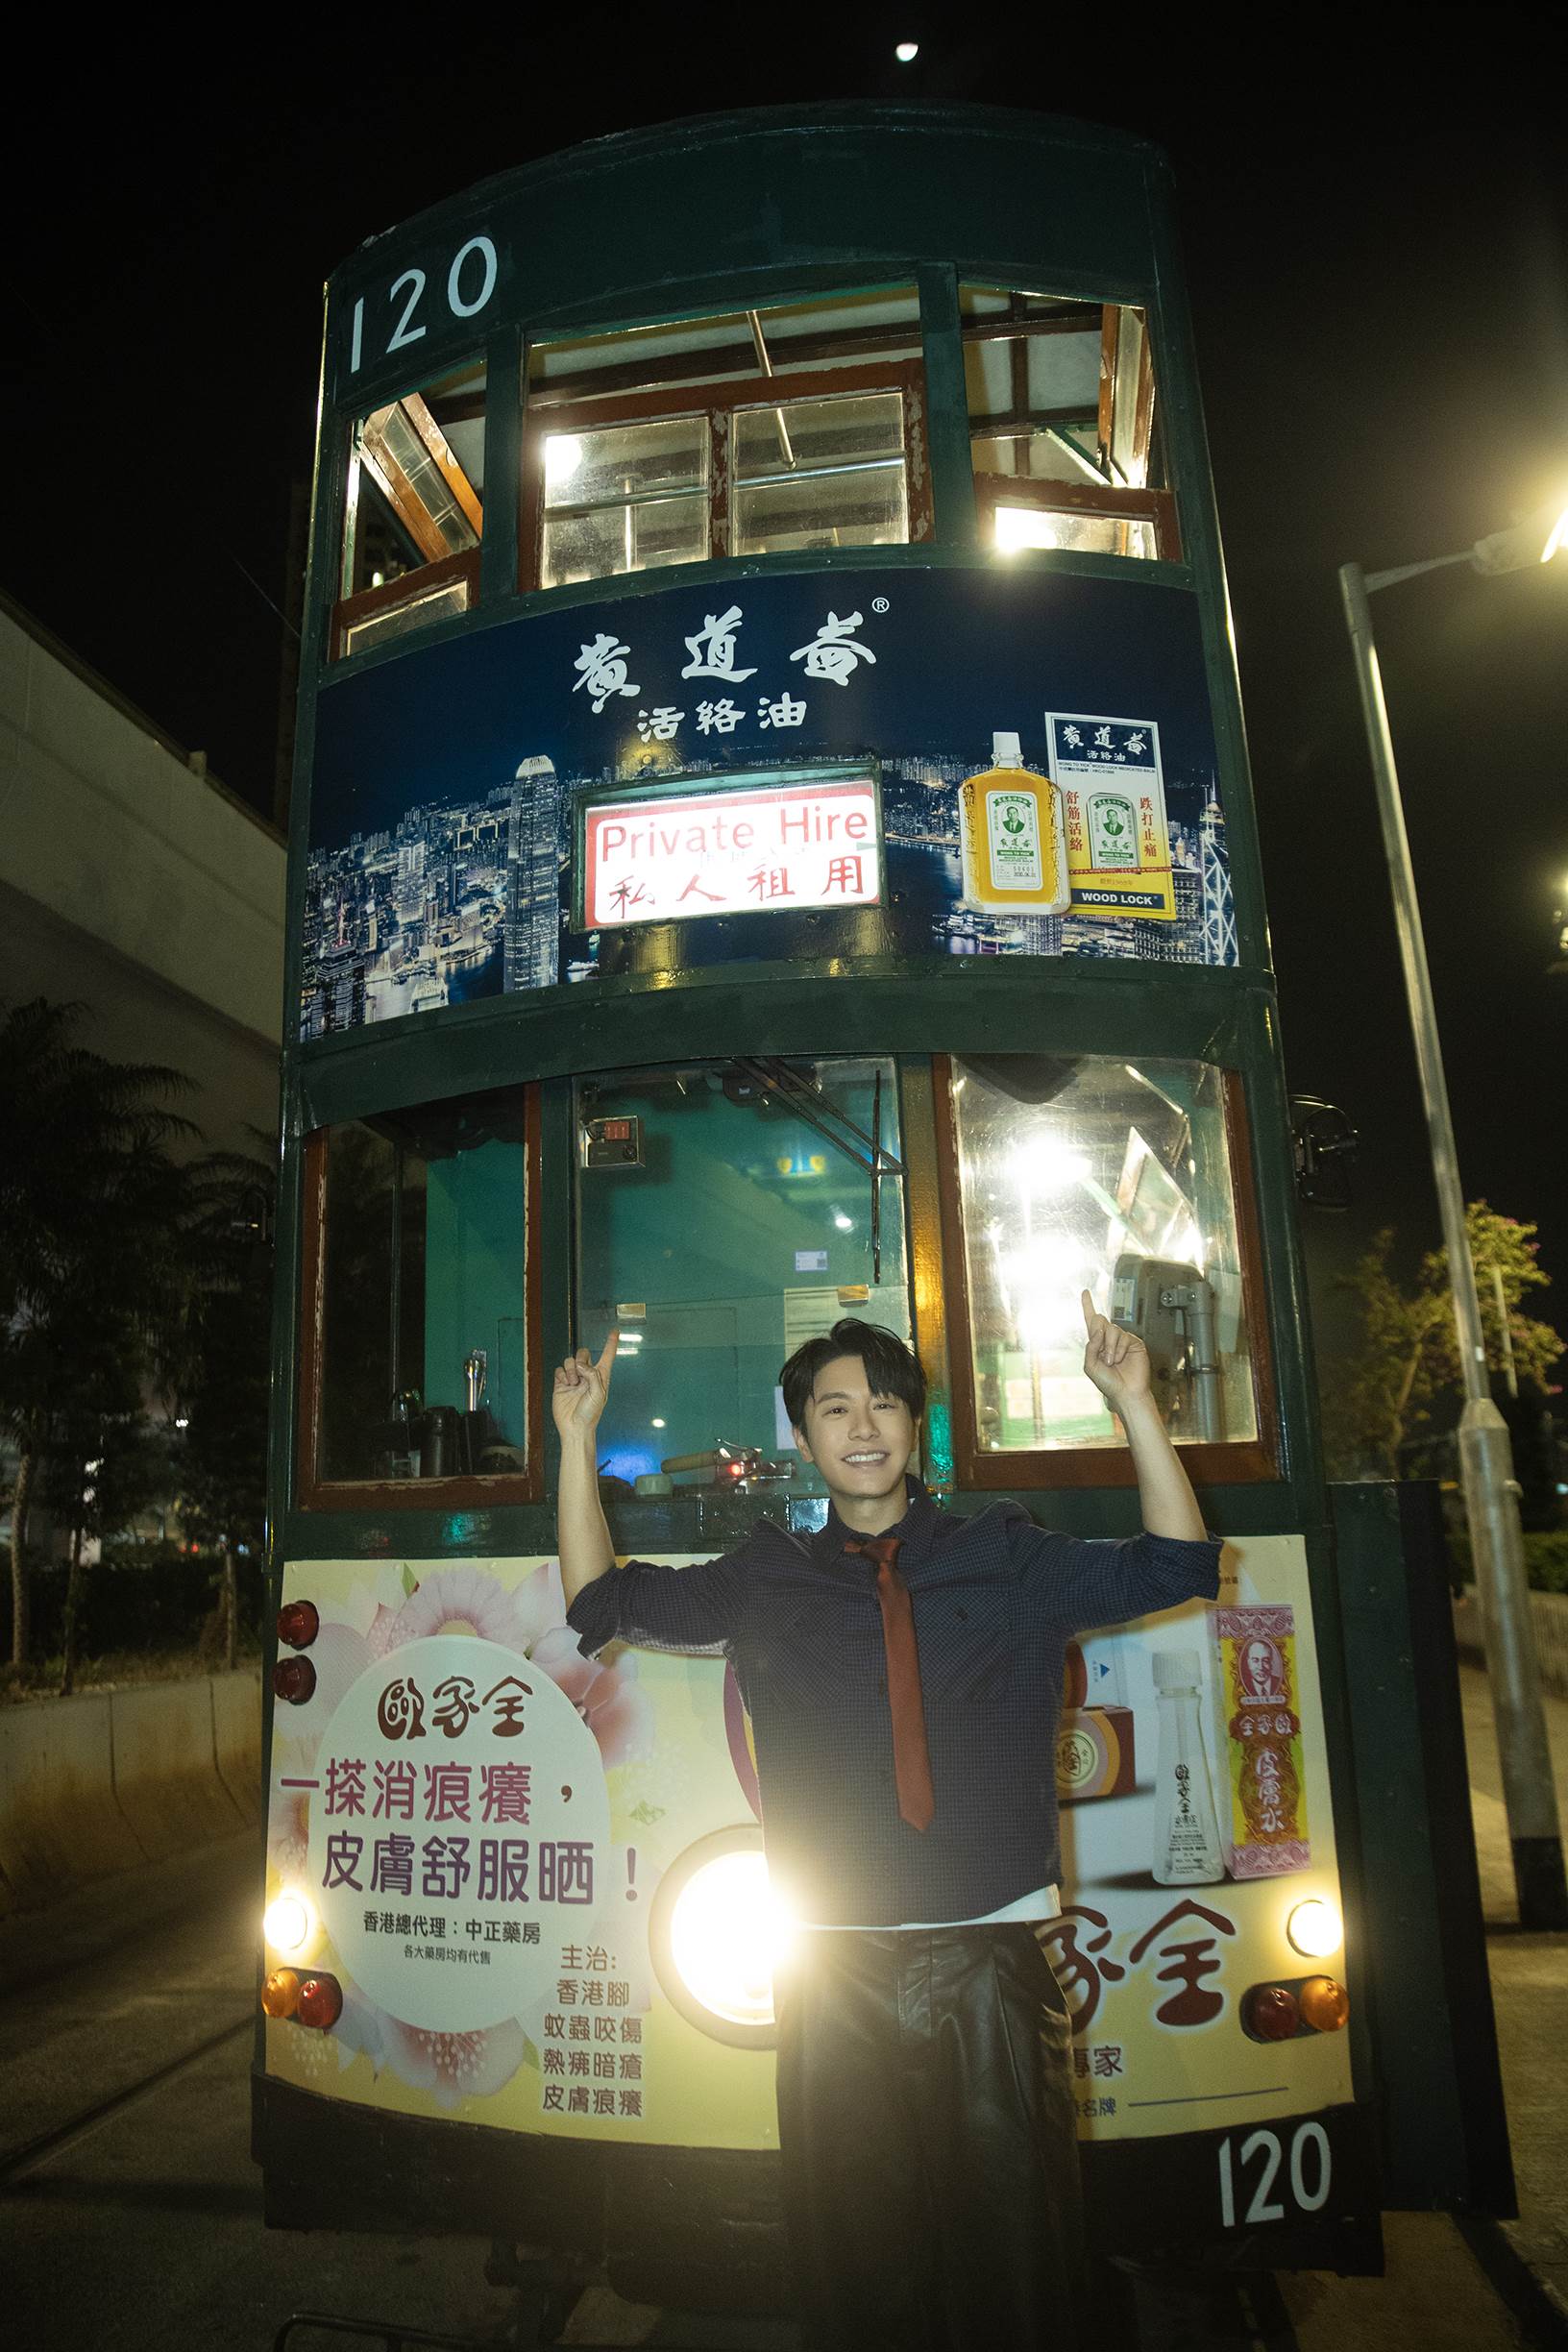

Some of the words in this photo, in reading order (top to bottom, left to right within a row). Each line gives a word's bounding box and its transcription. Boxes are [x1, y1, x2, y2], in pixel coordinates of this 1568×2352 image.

[350, 235, 498, 374] 120
[636, 691, 807, 743] 活絡油
[601, 816, 754, 862] Private
[779, 805, 868, 845] Hire
[1139, 796, 1157, 858] 跌打止痛
[609, 855, 864, 919] 私人租用
[1081, 892, 1118, 903] WOOD
[1121, 894, 1153, 905] LOCK
[404, 1944, 491, 1965] 各大藥房均有代售
[556, 1978, 630, 2007] 香港腳
[543, 2013, 643, 2044] 蚊蟲咬傷
[542, 2083, 643, 2118] 皮膚痕癢
[1218, 2120, 1333, 2228] 120
